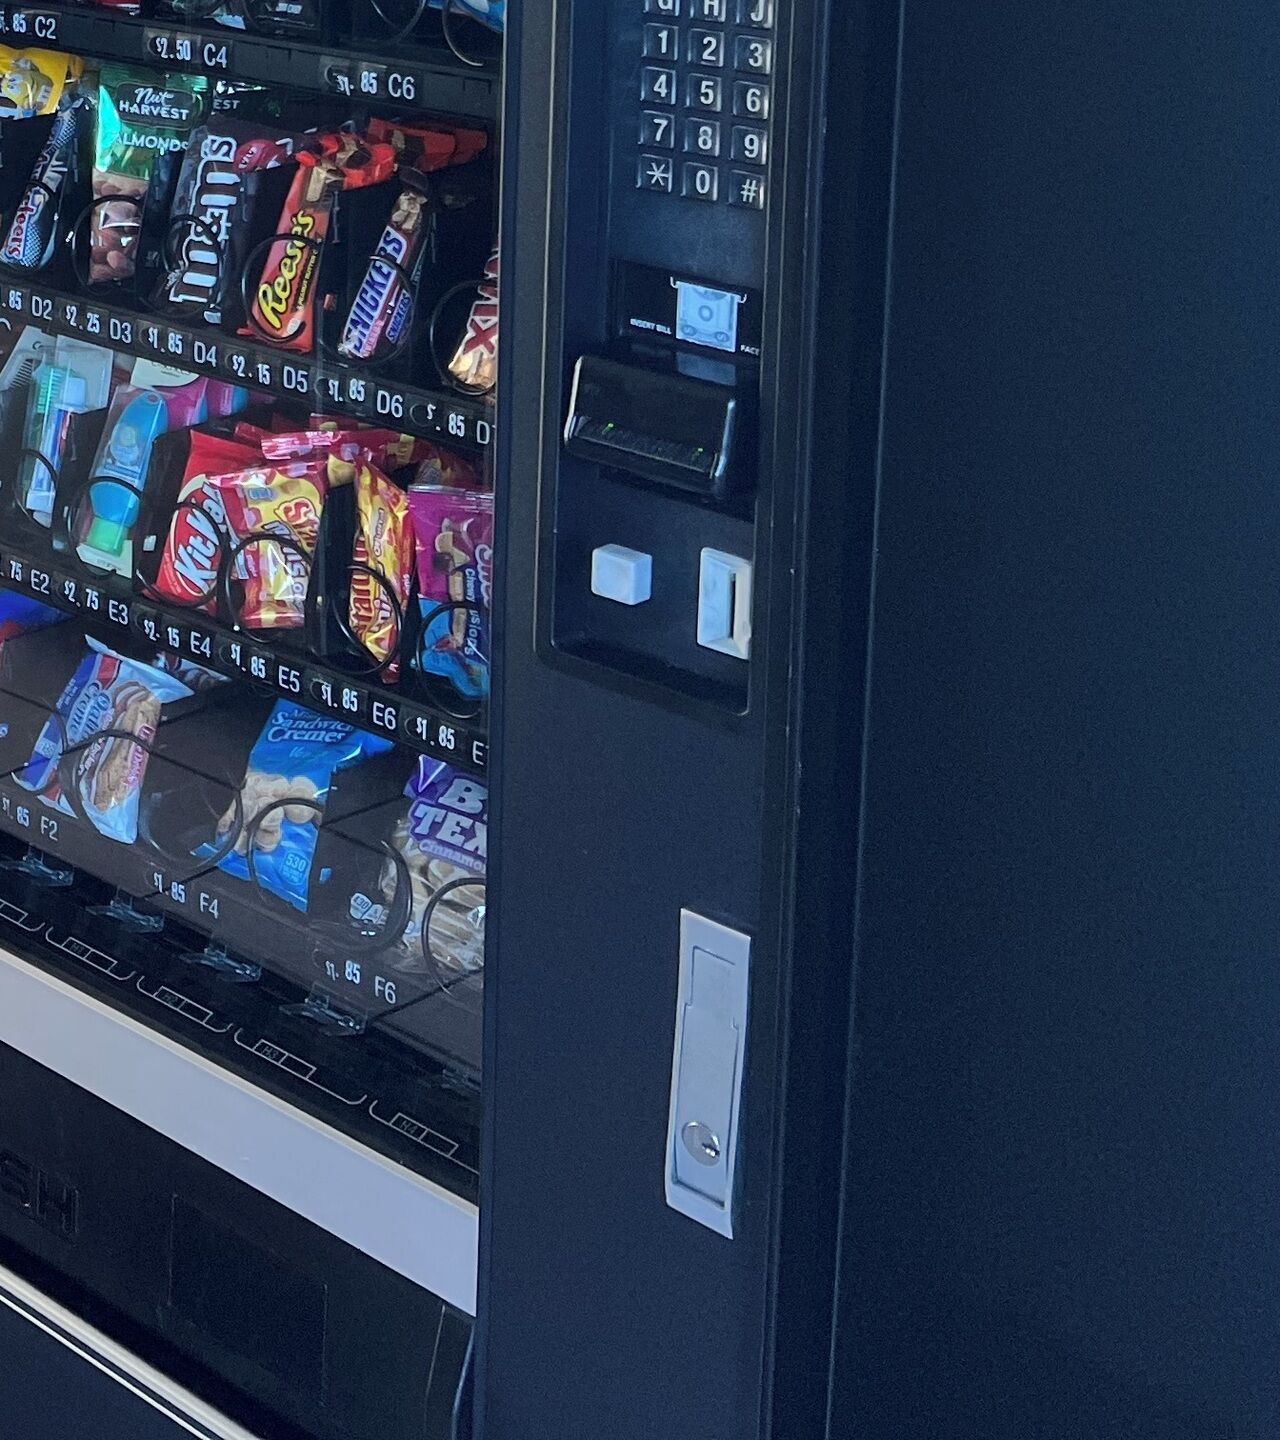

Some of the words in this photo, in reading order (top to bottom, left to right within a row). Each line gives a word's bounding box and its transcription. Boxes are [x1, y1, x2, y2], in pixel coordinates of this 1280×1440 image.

[35, 18, 56, 39] C2
[203, 44, 227, 68] C4
[658, 30, 668, 54] 1
[702, 36, 717, 62] 2
[748, 42, 763, 68] 3
[135, 87, 171, 105] Nut
[388, 74, 415, 100] C6
[653, 74, 667, 98] 4
[700, 80, 714, 105] 5
[746, 88, 761, 113] 6
[119, 102, 189, 121] HARVEST
[653, 118, 668, 142] 7
[698, 125, 713, 150] 8
[744, 133, 759, 159] 9
[695, 170, 710, 195] 0
[740, 179, 758, 204] #
[258, 210, 316, 330] Reese's
[343, 225, 408, 356] SNICKERS
[31, 296, 52, 320] D2
[109, 318, 132, 344] D3
[630, 318, 656, 332] INSERT
[657, 323, 672, 335] BILL
[193, 342, 217, 367] D4
[283, 367, 308, 393] D5
[376, 390, 403, 418] D6
[30, 568, 50, 594] E2
[464, 568, 476, 602] Chewy
[108, 599, 128, 625] E3
[190, 631, 212, 657] E4
[278, 665, 300, 692] E5
[372, 702, 396, 731] E6
[41, 818, 59, 841] F2
[200, 892, 219, 919] F4
[374, 976, 396, 1004] F6
